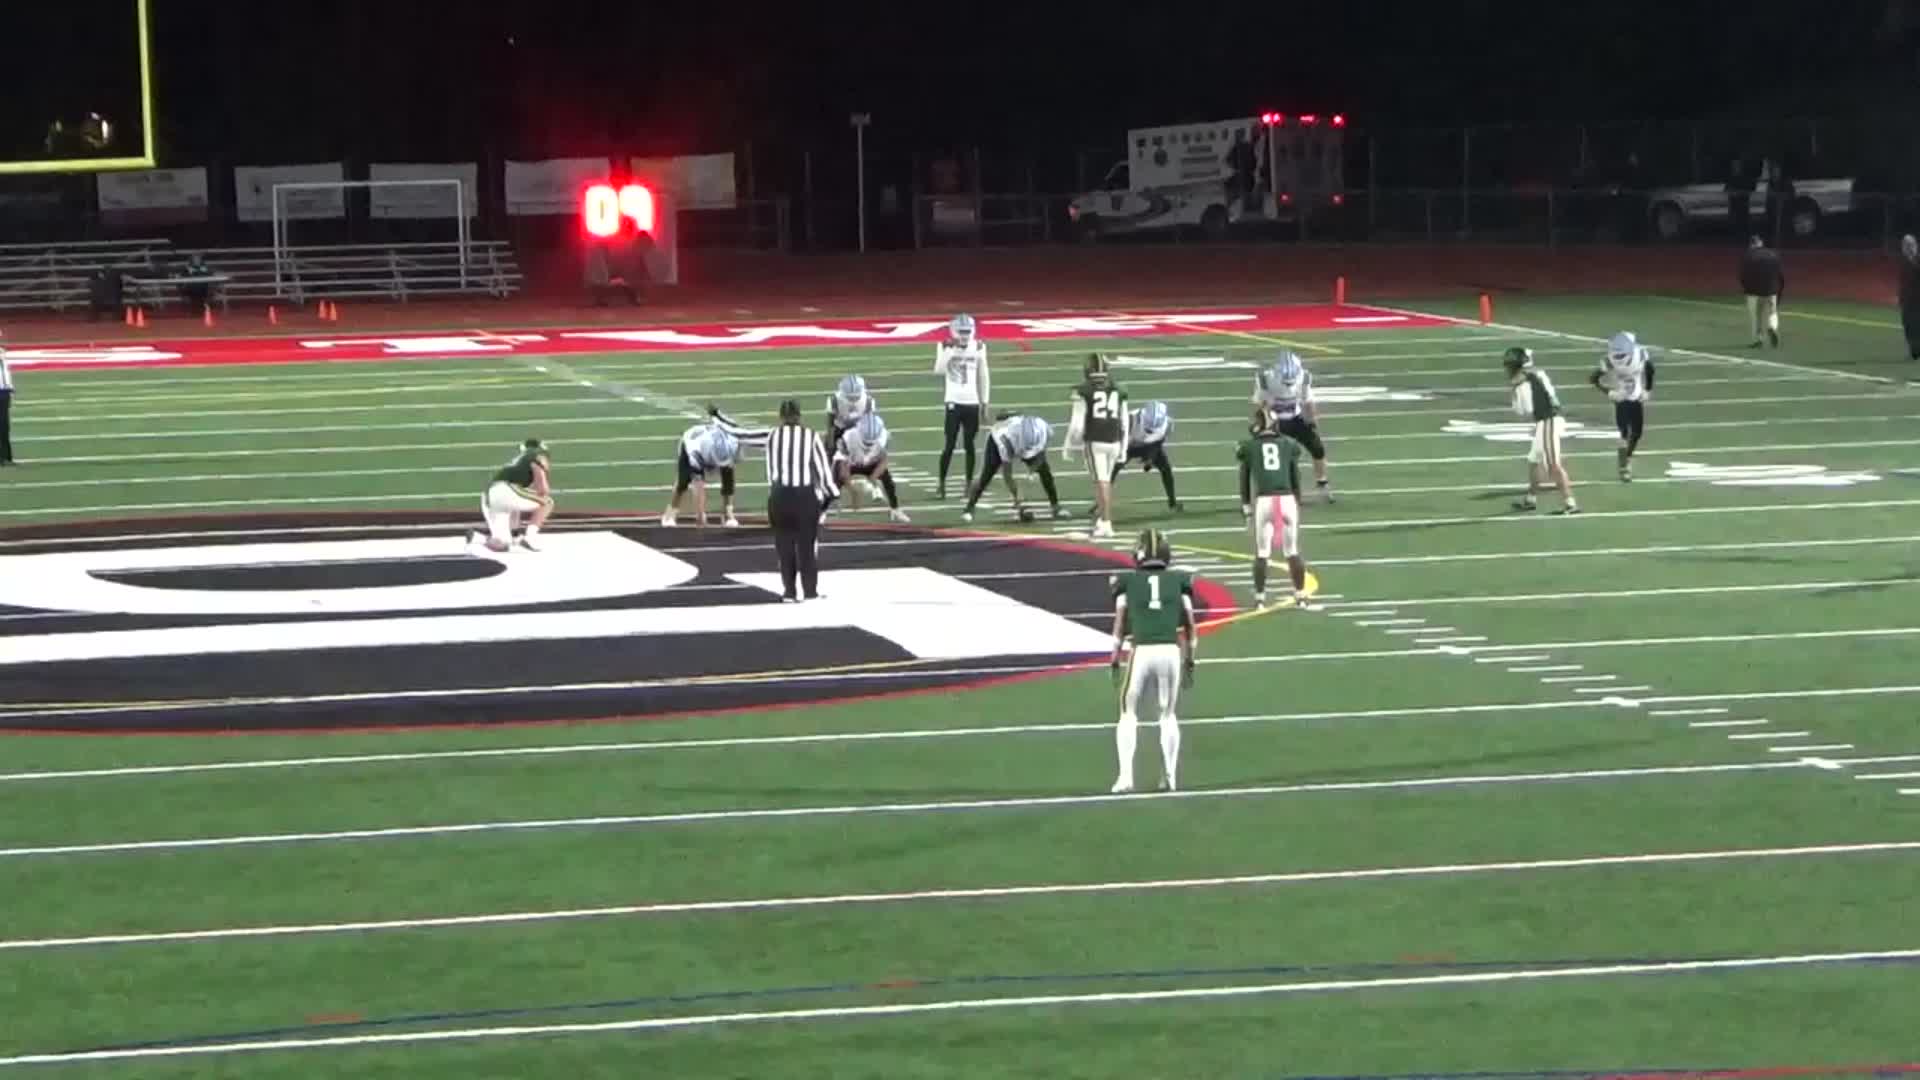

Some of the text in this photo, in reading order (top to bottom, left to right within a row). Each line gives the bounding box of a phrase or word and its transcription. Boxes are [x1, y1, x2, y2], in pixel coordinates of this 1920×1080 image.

[1092, 390, 1120, 419] 24
[1262, 442, 1281, 471] 8
[1146, 575, 1162, 610] 1
